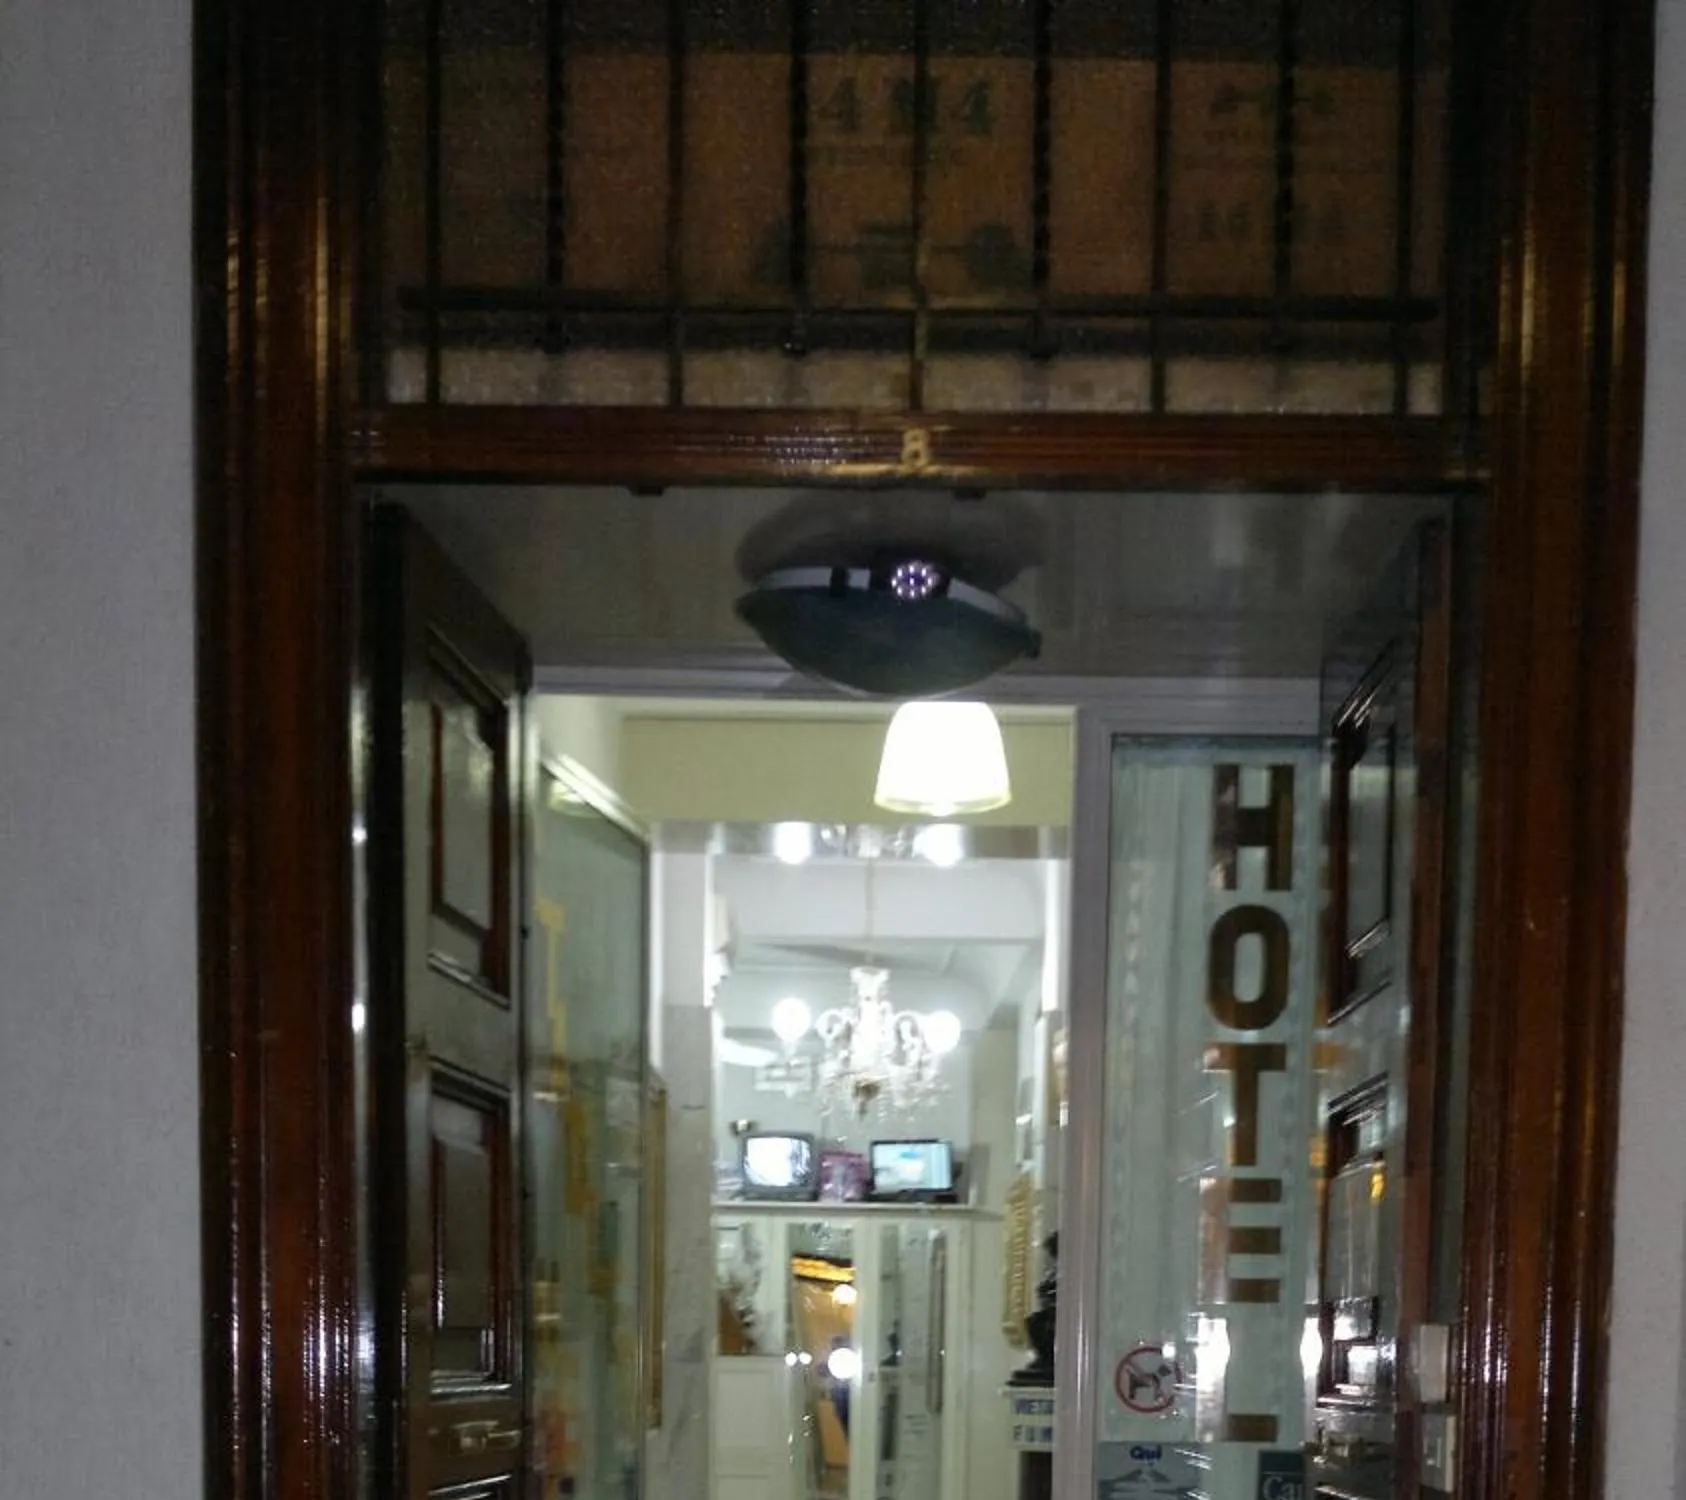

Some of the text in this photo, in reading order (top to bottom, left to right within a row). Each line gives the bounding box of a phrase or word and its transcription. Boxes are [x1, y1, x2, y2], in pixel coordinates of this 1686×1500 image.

[900, 427, 931, 469] 8
[1199, 762, 1296, 1444] HOTEL
[1130, 1445, 1162, 1460] Qui
